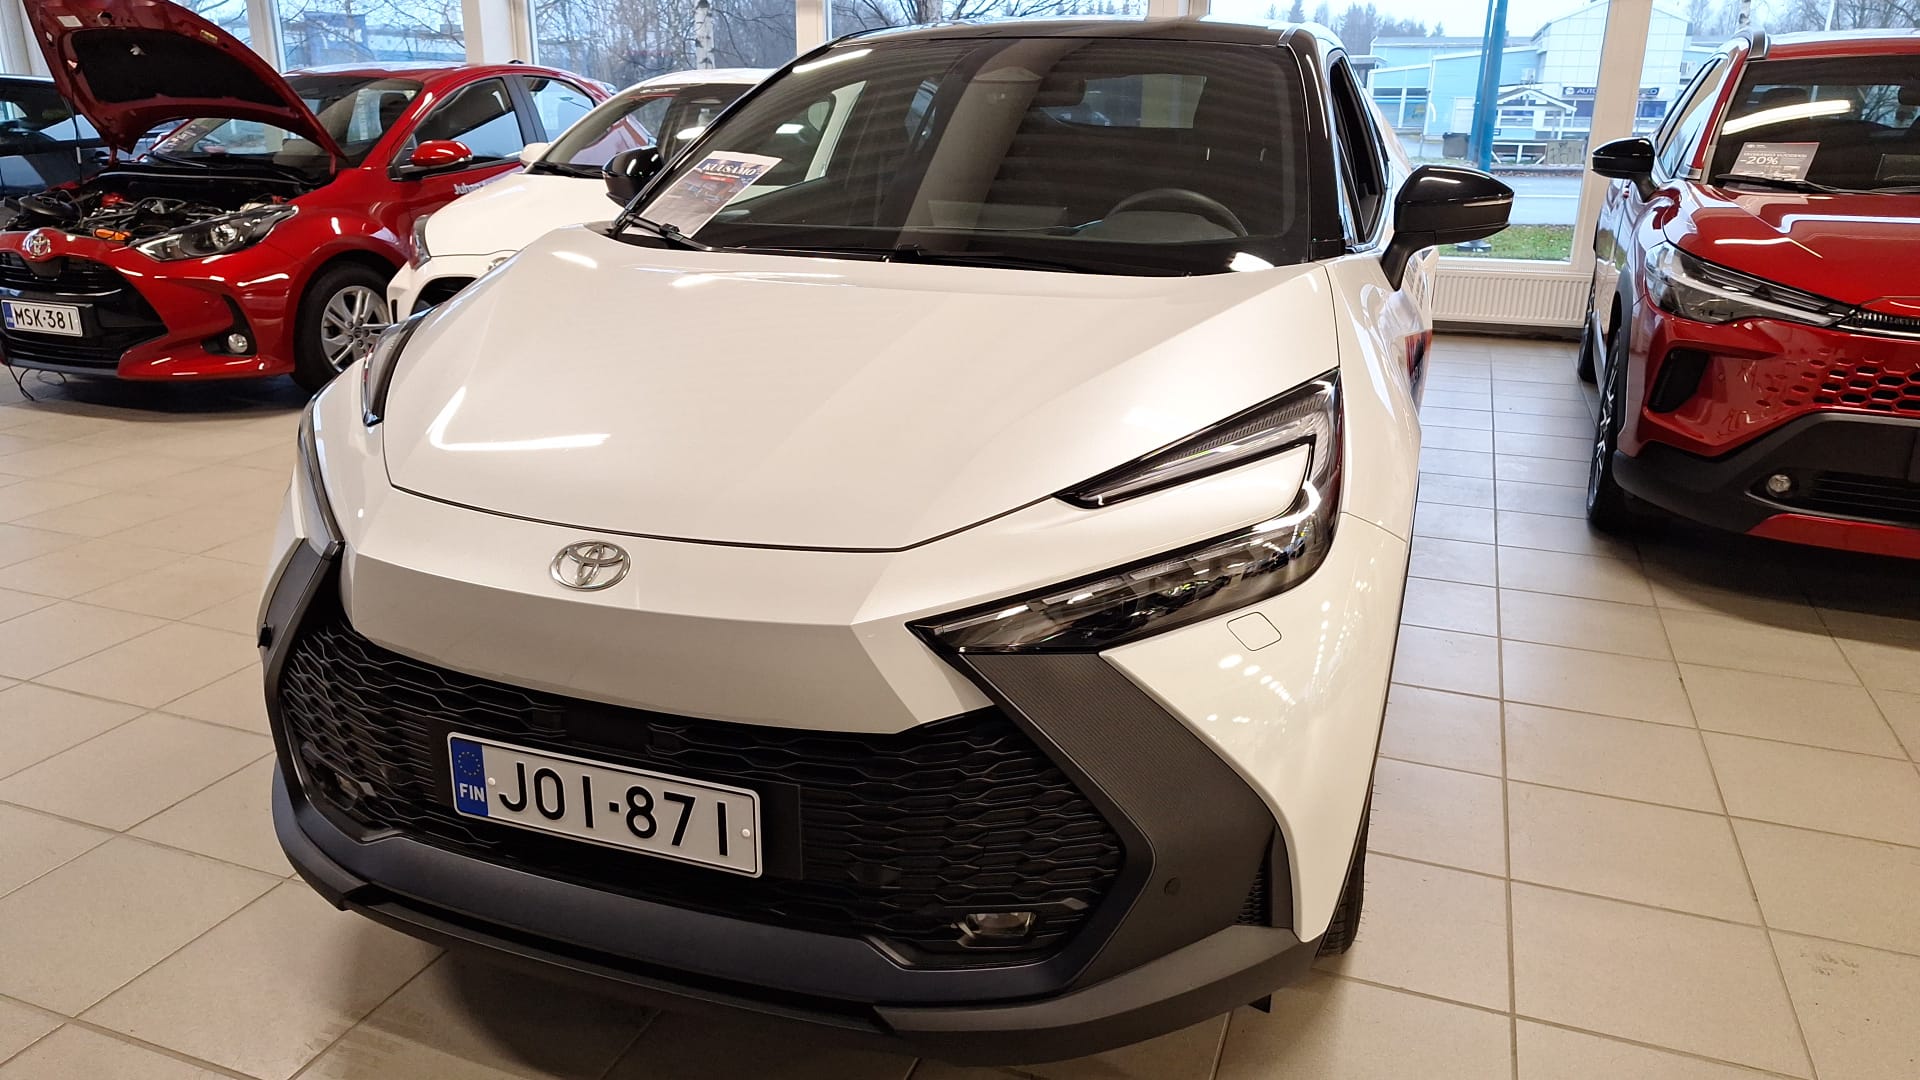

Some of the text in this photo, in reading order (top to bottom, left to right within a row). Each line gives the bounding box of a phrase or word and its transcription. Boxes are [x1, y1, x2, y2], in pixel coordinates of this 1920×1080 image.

[1740, 156, 1778, 165] -20%
[14, 308, 73, 330] MSK-381
[459, 762, 728, 856] FIN JOI-871
